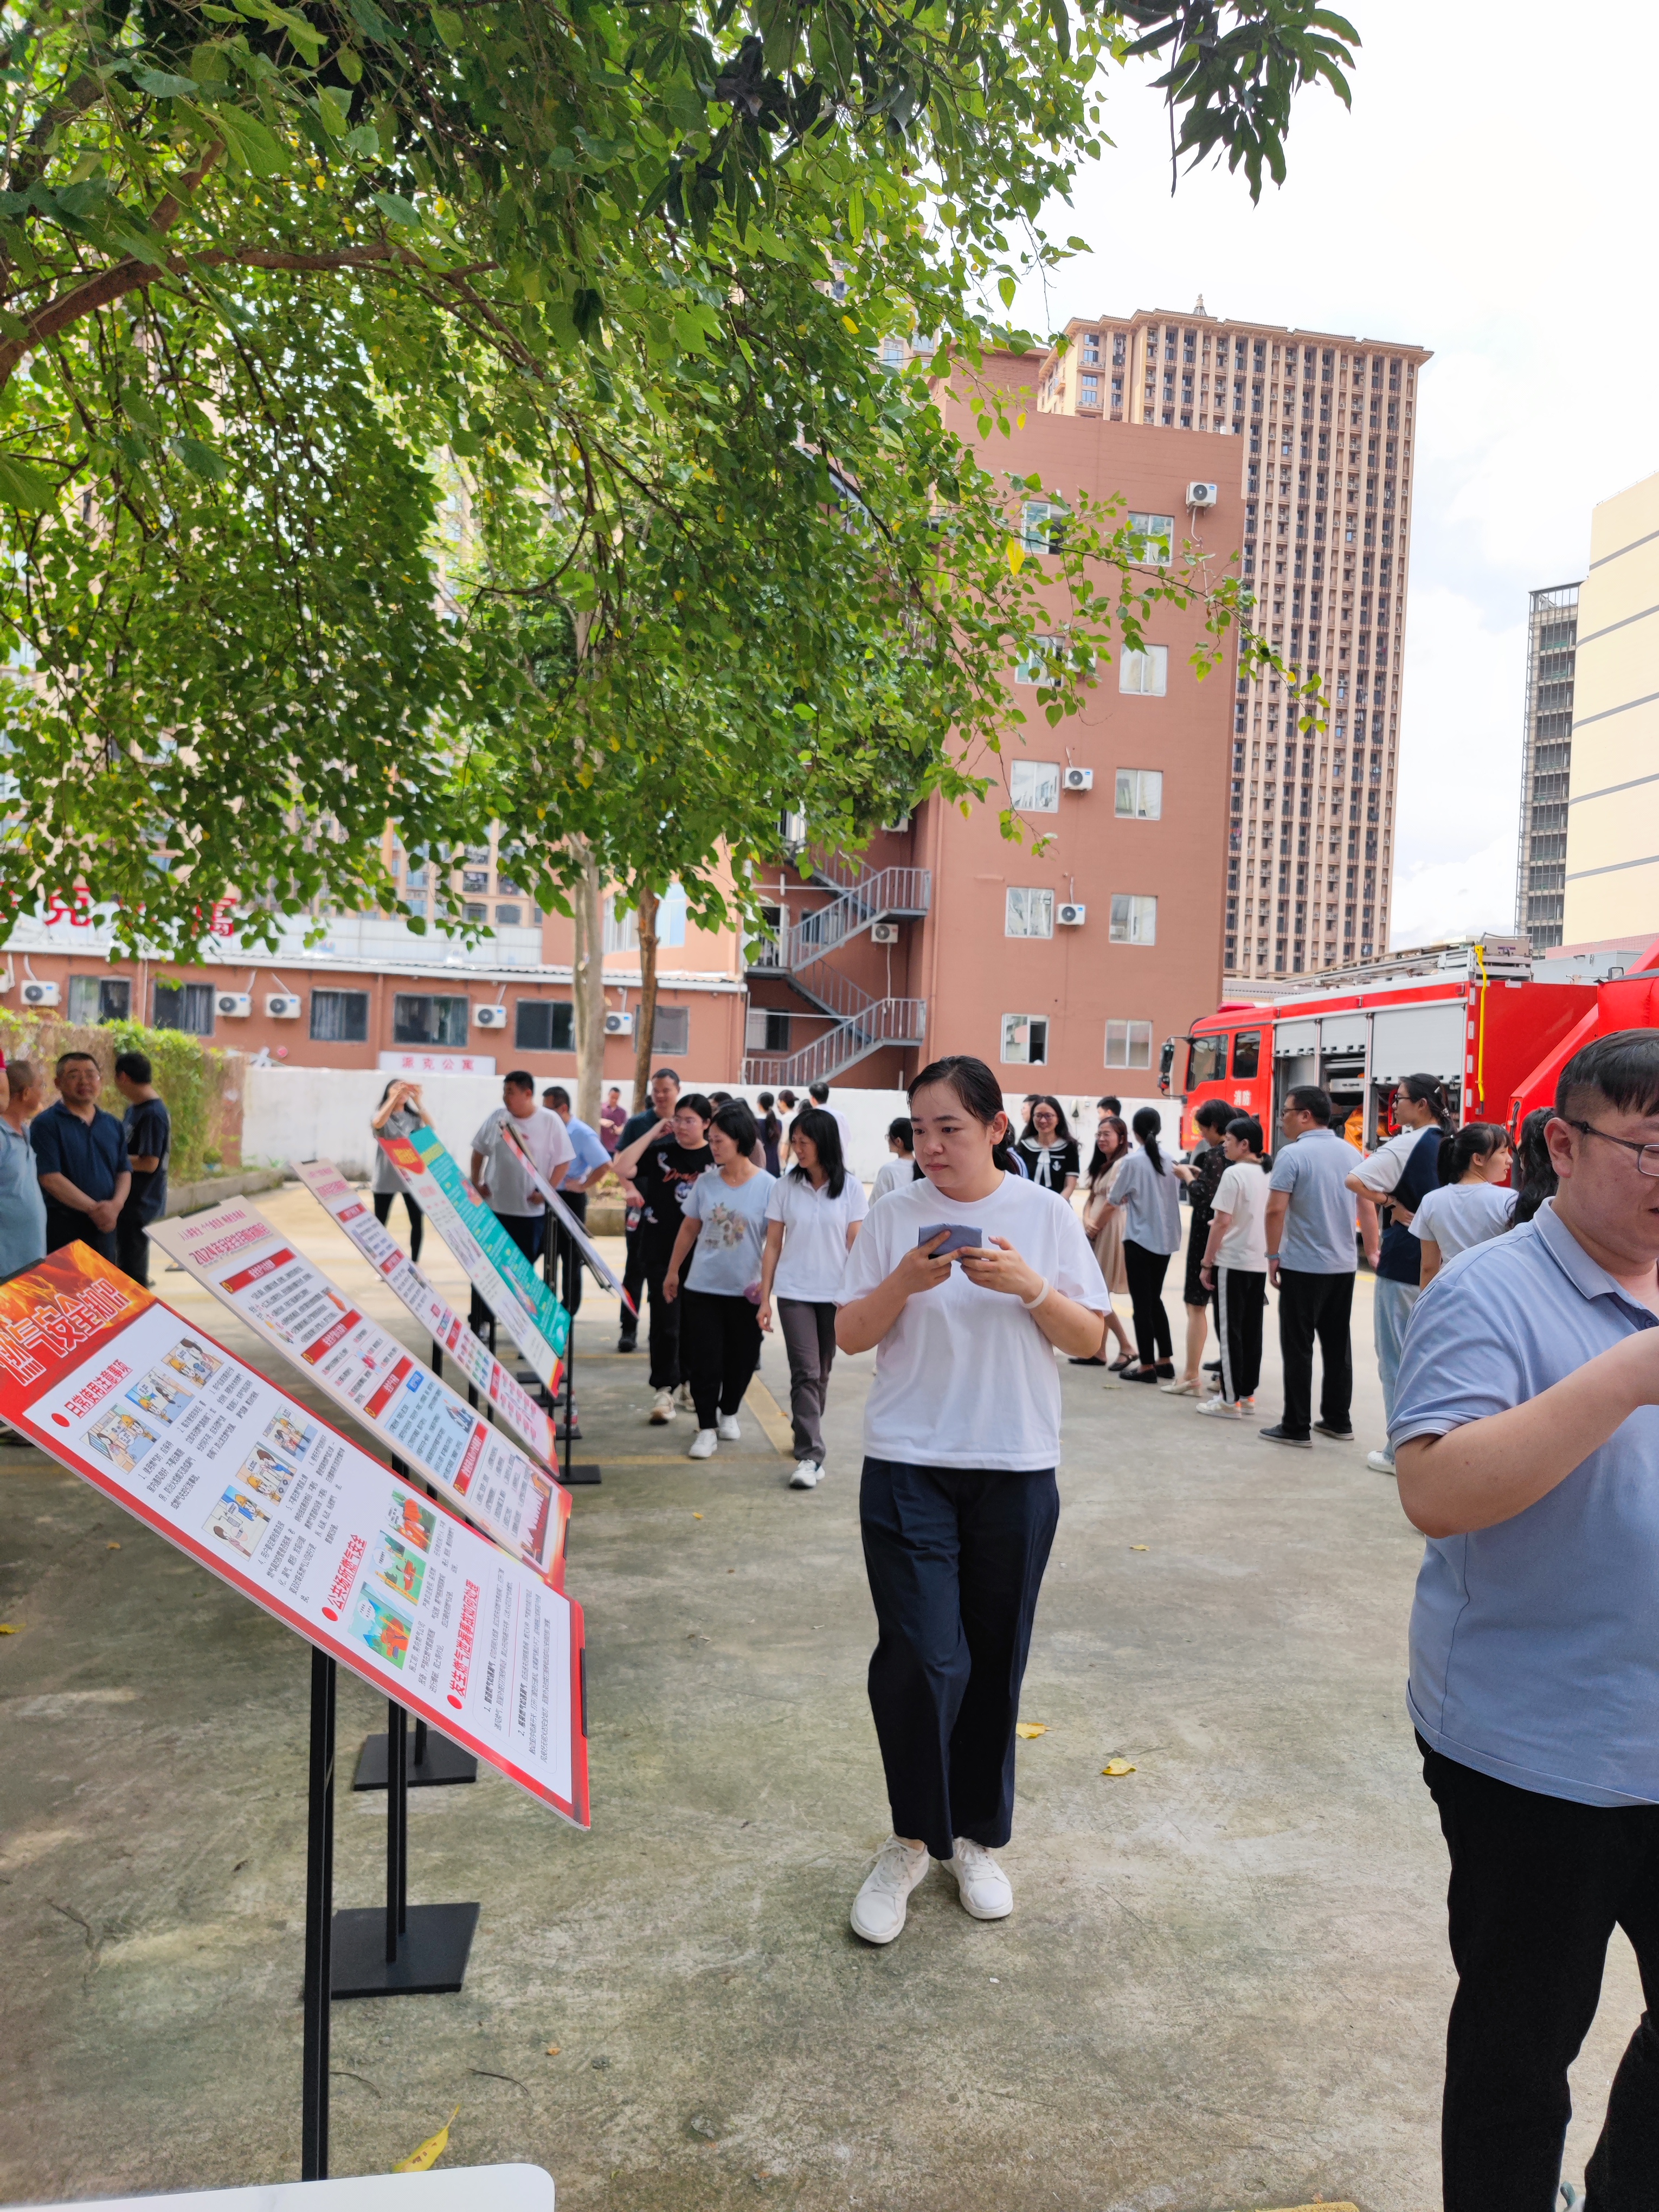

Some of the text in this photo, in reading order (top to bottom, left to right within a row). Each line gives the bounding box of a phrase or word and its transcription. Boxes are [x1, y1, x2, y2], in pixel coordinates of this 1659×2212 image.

[1233, 1090, 1251, 1107] 消防
[62, 1358, 133, 1418] 日常使用注意事项
[325, 1531, 367, 1611] 公共场所燃气安全
[448, 1578, 480, 1698] 发生燃气泄漏事故如何处理
